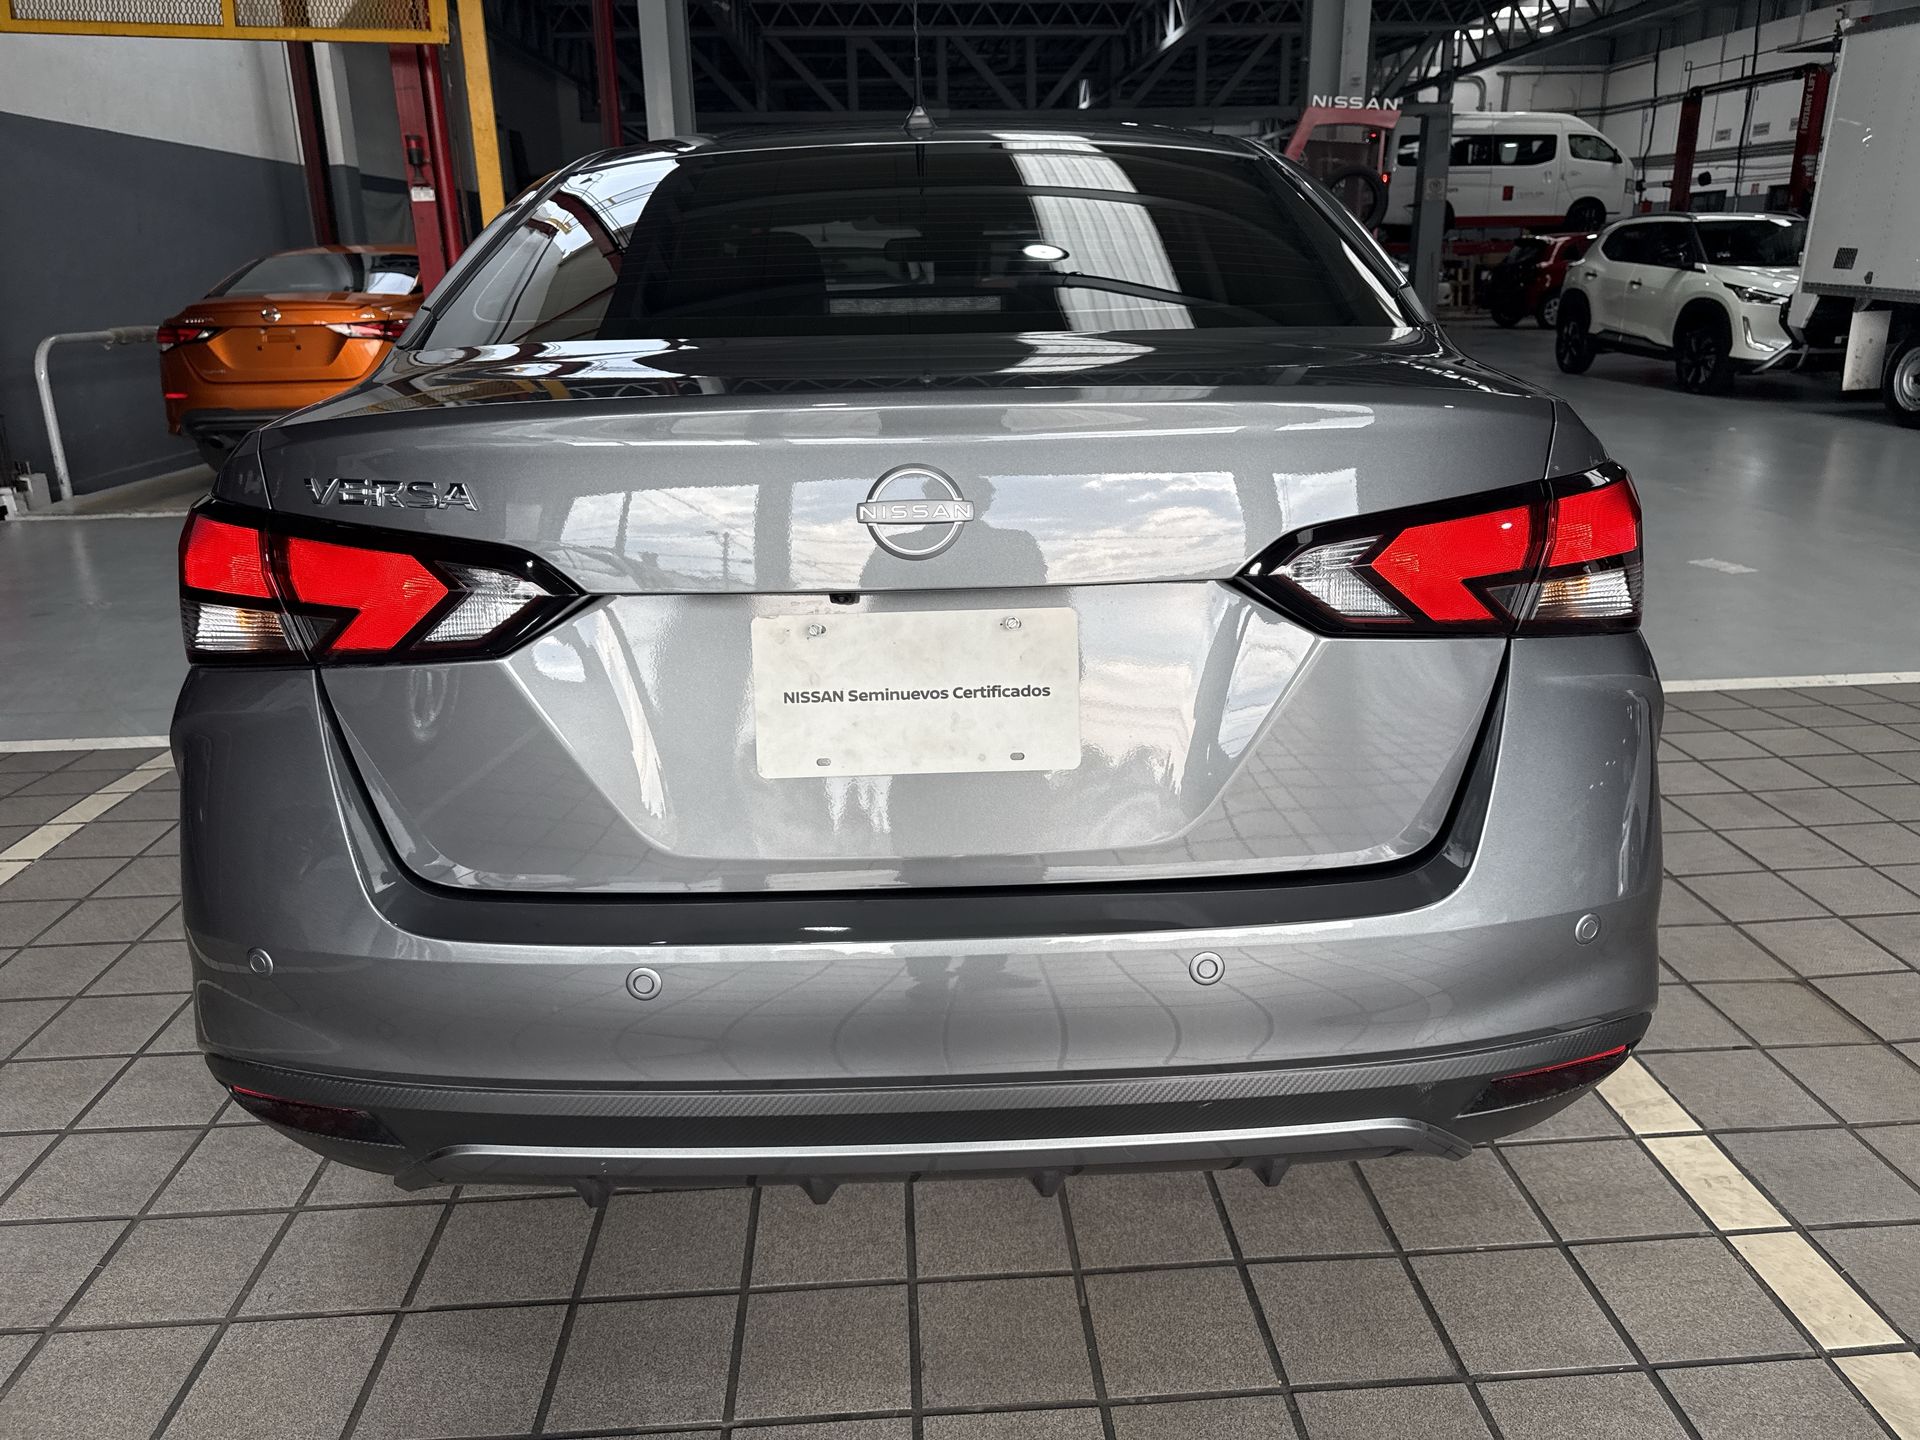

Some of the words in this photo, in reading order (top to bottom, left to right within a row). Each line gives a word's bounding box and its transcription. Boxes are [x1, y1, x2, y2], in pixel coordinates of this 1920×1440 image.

[1312, 95, 1398, 111] NISSAN
[1801, 94, 1813, 129] ROTARY
[1807, 72, 1817, 91] LIFT
[304, 478, 478, 511] VERSA
[859, 504, 971, 520] NISSAN
[783, 690, 844, 704] NISSAN
[848, 687, 949, 702] Seminuevos
[952, 685, 1051, 700] Certificados
